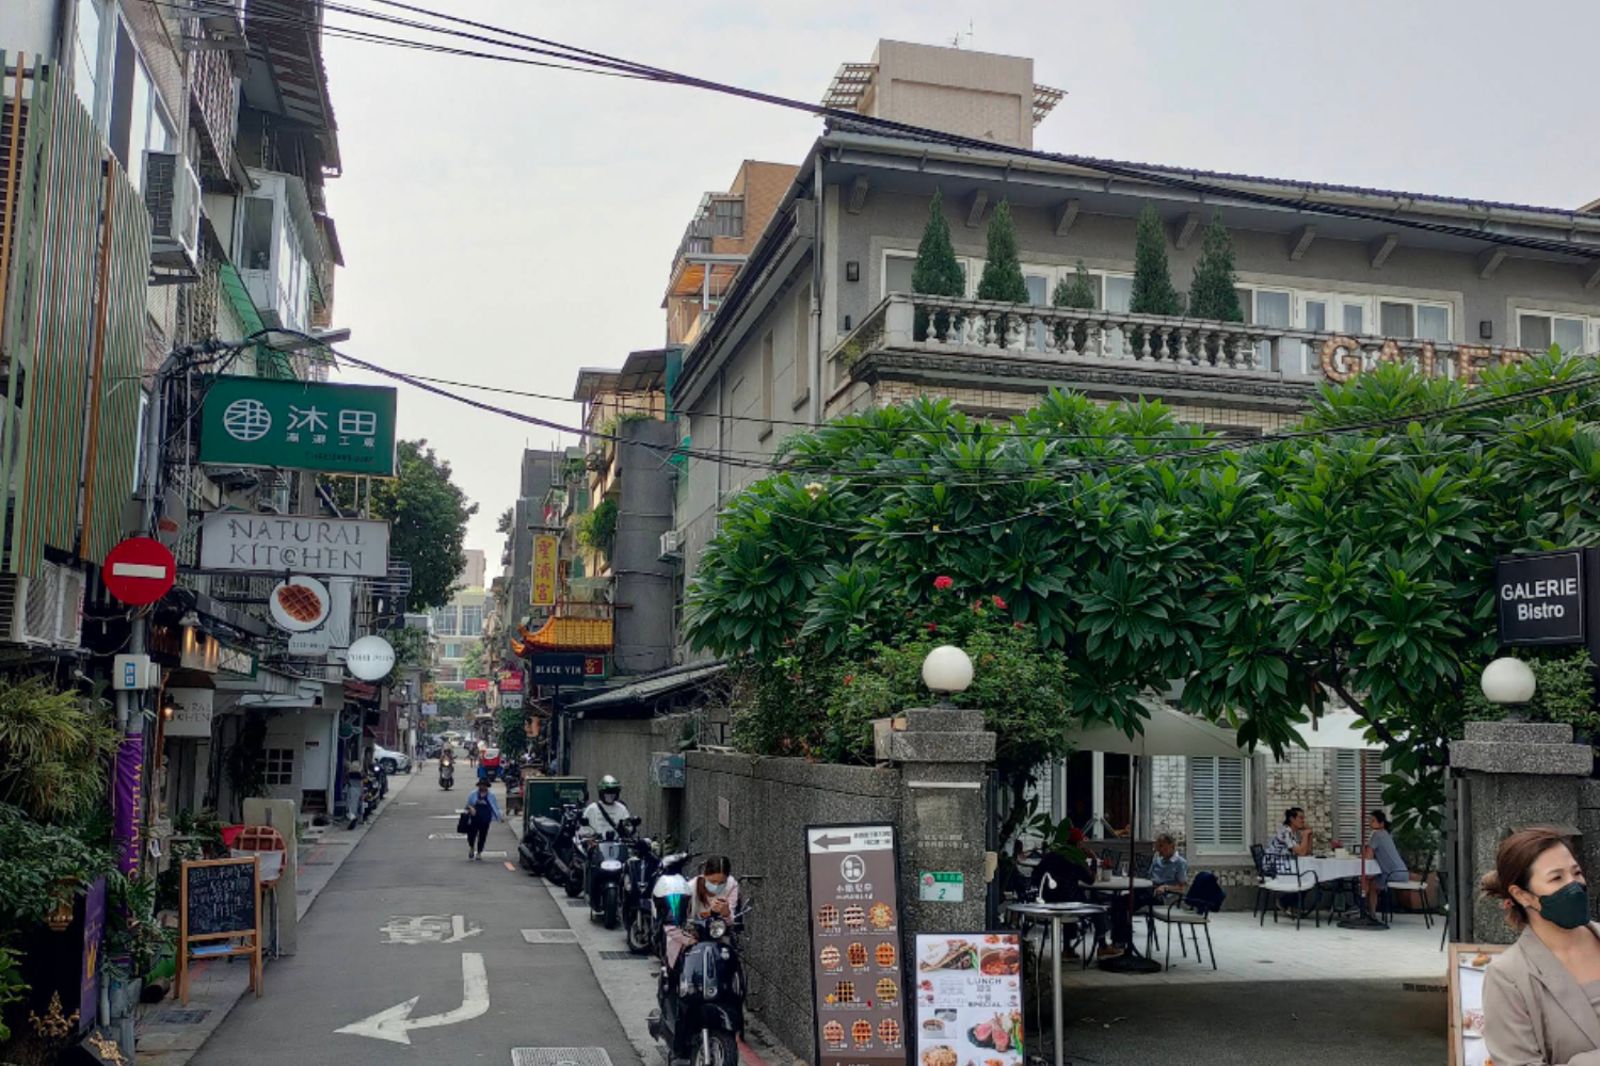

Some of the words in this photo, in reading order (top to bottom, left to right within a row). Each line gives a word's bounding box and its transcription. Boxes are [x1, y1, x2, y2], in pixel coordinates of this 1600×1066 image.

[286, 405, 377, 436] 沐田
[228, 518, 366, 546] NATURAL
[1501, 577, 1577, 601] GALERIE
[1517, 602, 1565, 621] Bistro
[938, 888, 946, 900] 2
[966, 977, 1002, 986] LUNCH
